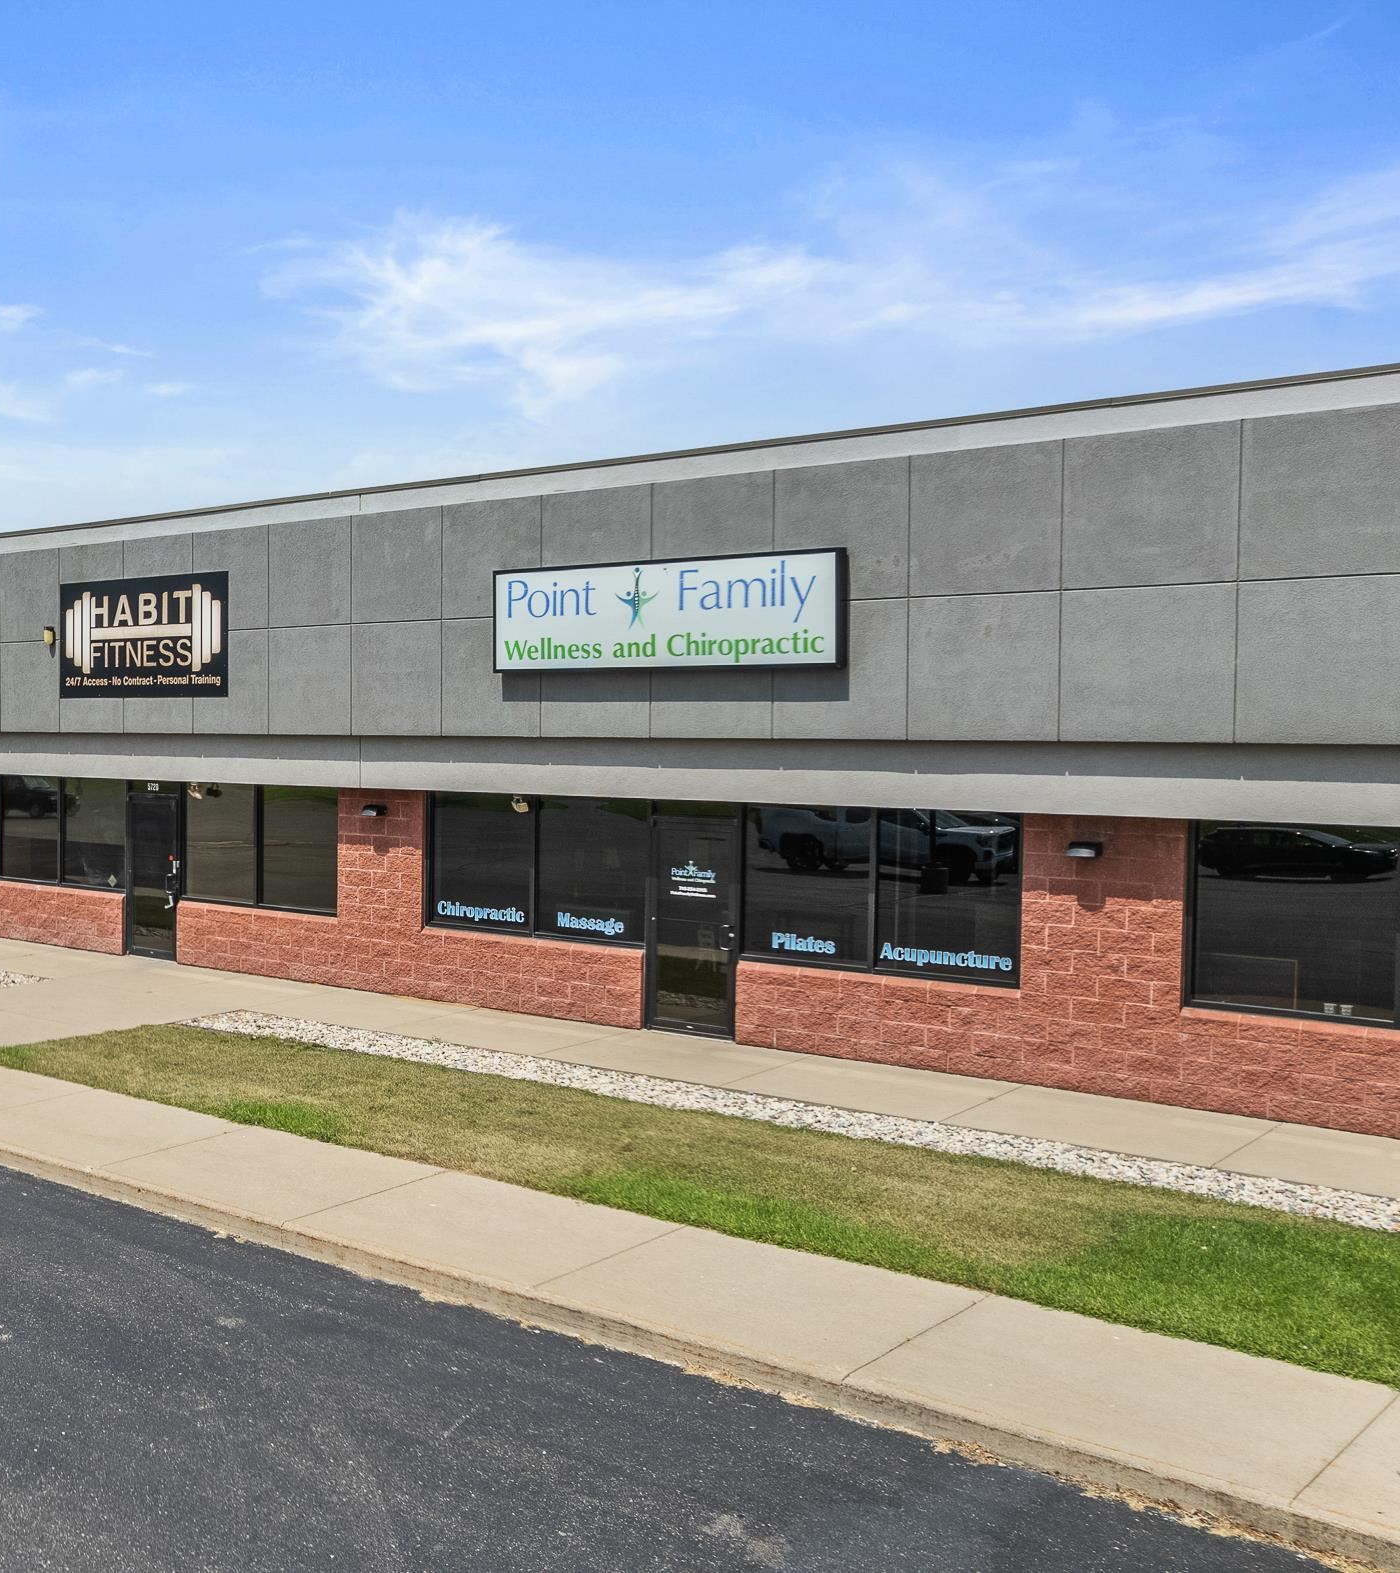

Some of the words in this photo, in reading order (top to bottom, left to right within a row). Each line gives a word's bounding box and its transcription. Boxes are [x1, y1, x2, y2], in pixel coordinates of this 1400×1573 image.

[507, 578, 597, 619] Point
[677, 560, 817, 623] Family
[91, 590, 192, 628] HABIT
[91, 638, 192, 669] FITNESS
[503, 637, 602, 662] Wellness
[612, 633, 657, 659] and
[666, 628, 826, 663] Chiropractic
[65, 676, 82, 687] 24/7
[190, 674, 221, 686] Training
[437, 900, 525, 923] Chiropractic
[557, 911, 625, 936] Massage
[771, 931, 836, 955] Pilates
[879, 942, 1013, 971] Acupuncture
